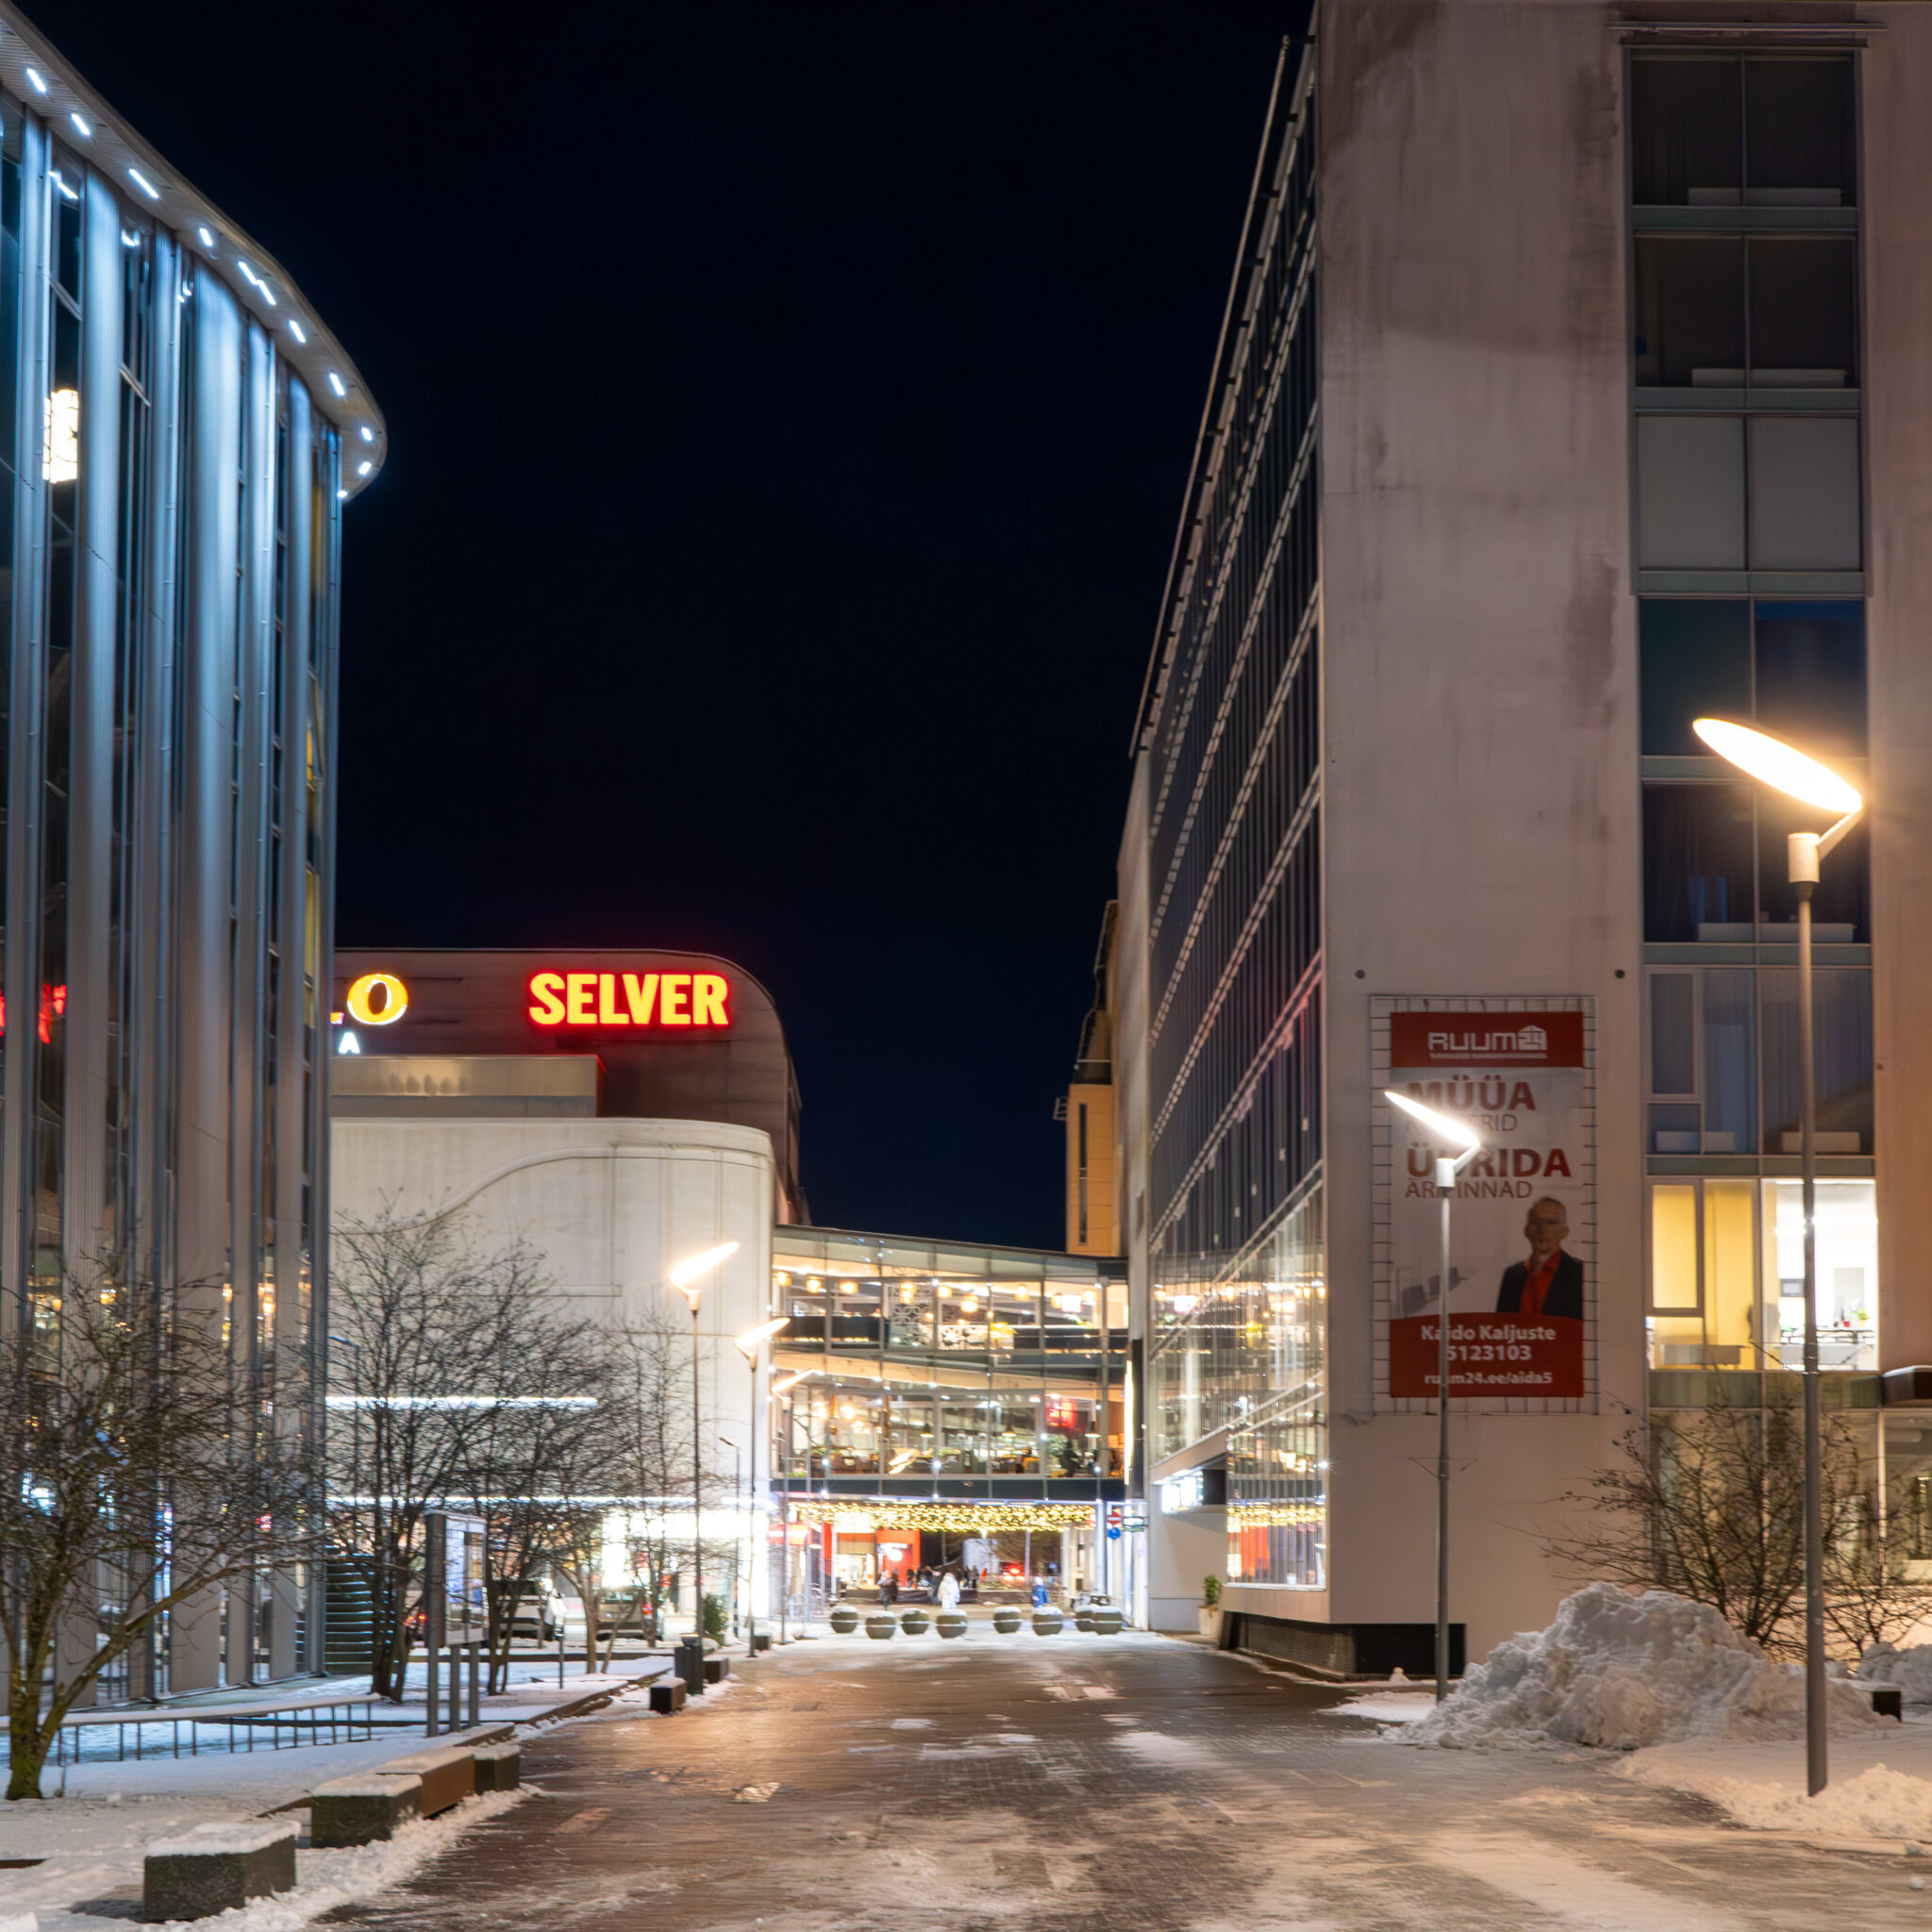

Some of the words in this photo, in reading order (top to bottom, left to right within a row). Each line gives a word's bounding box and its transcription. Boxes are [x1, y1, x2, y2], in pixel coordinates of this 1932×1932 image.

[528, 973, 729, 1025] SELVER
[1407, 1141, 1572, 1177] ÜRIDA
[1421, 1324, 1476, 1341] Kado
[1478, 1324, 1557, 1344] Kaljuste
